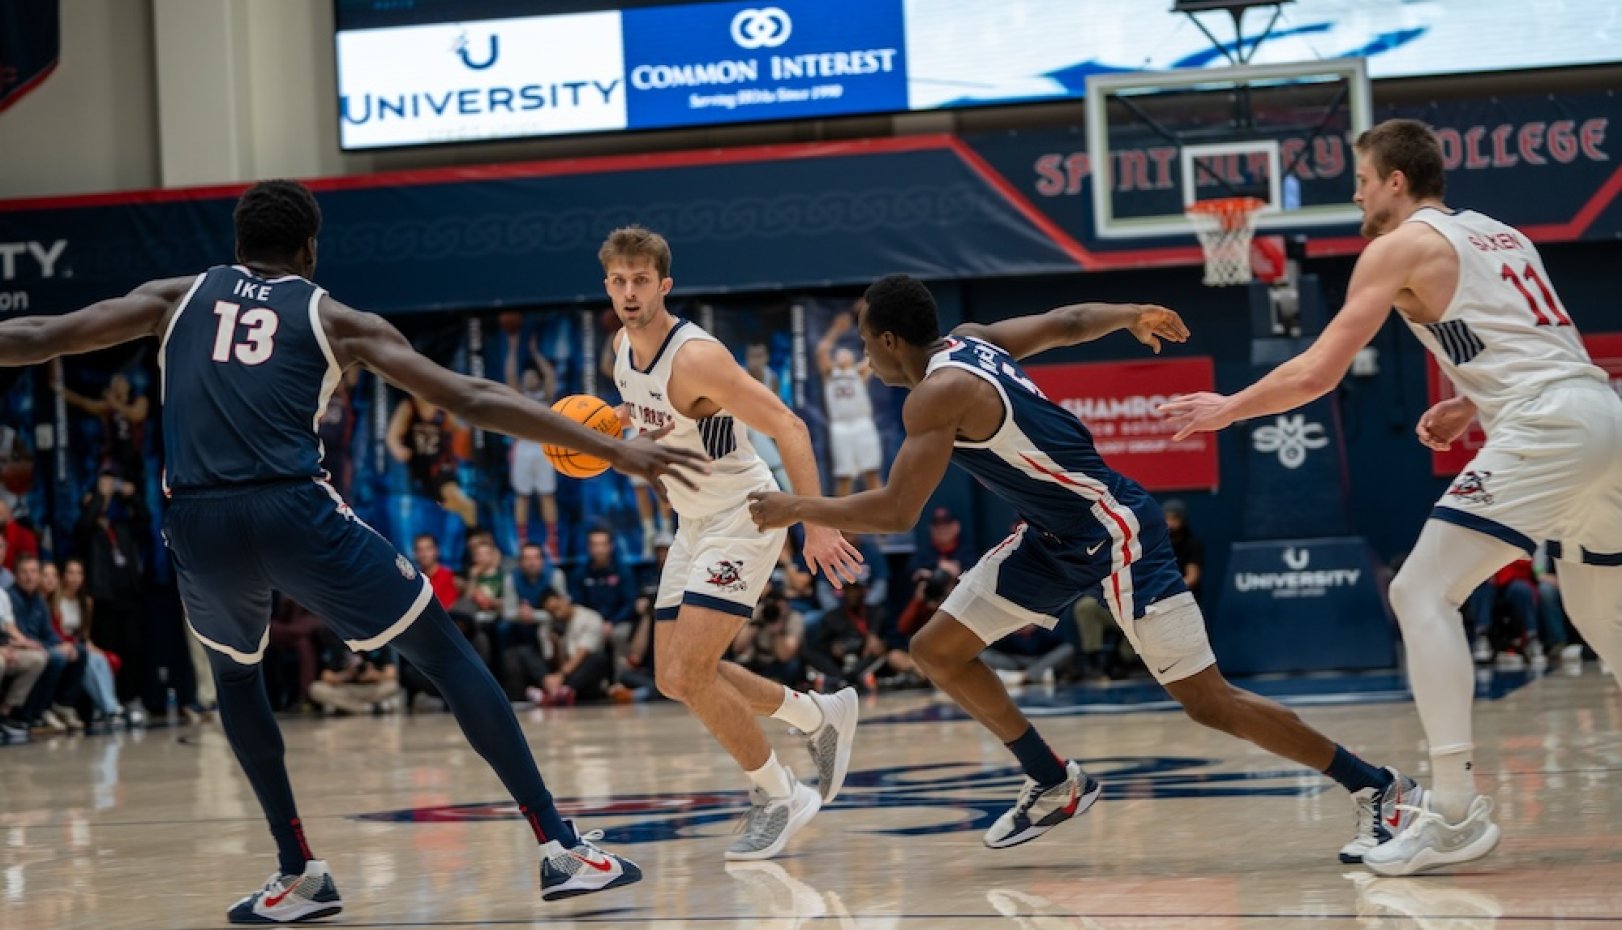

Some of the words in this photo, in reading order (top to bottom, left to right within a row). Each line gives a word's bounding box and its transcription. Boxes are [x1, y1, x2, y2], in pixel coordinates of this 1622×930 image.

[630, 59, 758, 90] COMMON
[770, 48, 897, 81] INTEREST
[340, 79, 620, 125] UNIVERSITY
[1438, 117, 1610, 170] OLLEGE
[233, 278, 273, 302] IKE
[1501, 262, 1572, 327] 11
[211, 300, 279, 366] 13
[1060, 393, 1186, 419] SHAMROC
[1234, 568, 1361, 592] UNIVERSITY
